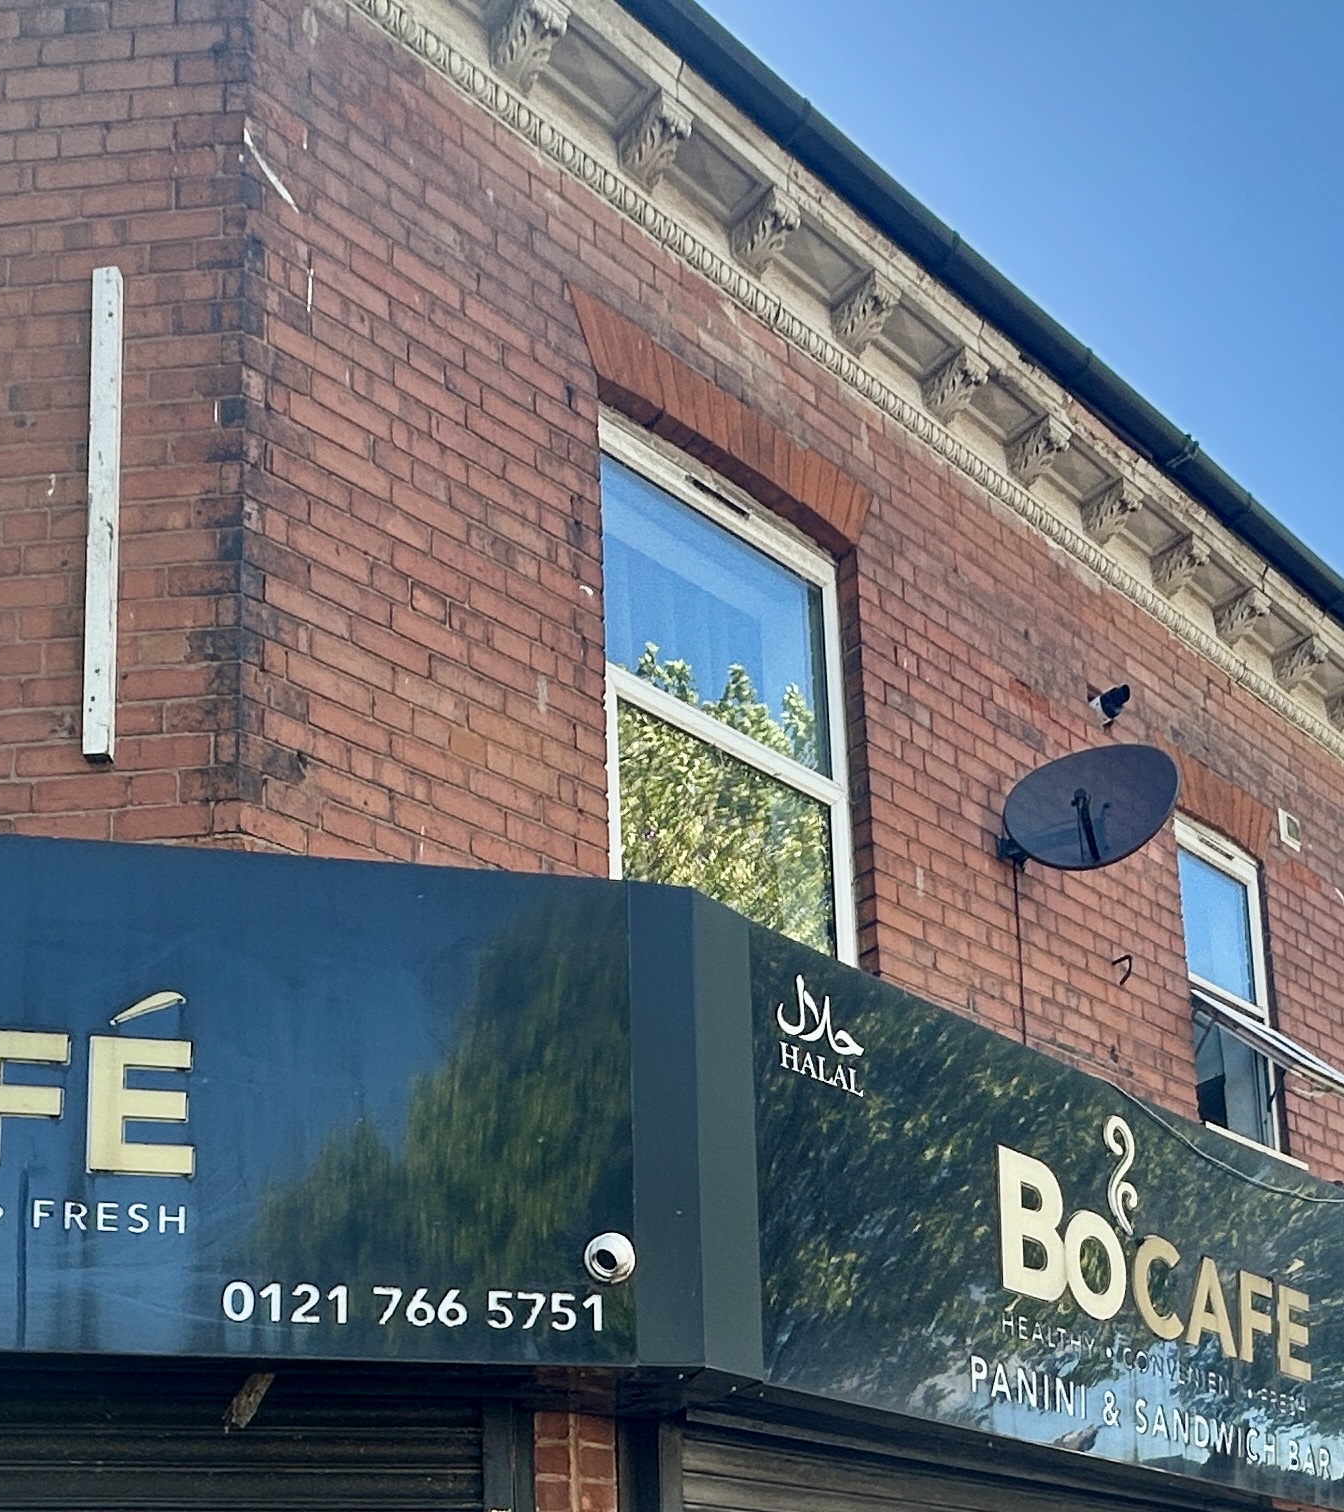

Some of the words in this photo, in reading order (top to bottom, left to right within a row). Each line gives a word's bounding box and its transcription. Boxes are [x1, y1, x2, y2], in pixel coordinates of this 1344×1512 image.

[777, 974, 864, 1056] حلال
[779, 1040, 864, 1097] HALAL
[33, 1200, 188, 1235] FRESH
[222, 1281, 349, 1325] 0121
[372, 1286, 468, 1328] 766
[487, 1290, 605, 1332] 5751
[1002, 1313, 1096, 1352] HEALTHY
[970, 1355, 1087, 1420] PANINI
[1103, 1391, 1120, 1427] &
[1135, 1398, 1276, 1465] SANDWICH
[1289, 1440, 1331, 1480] BAR
